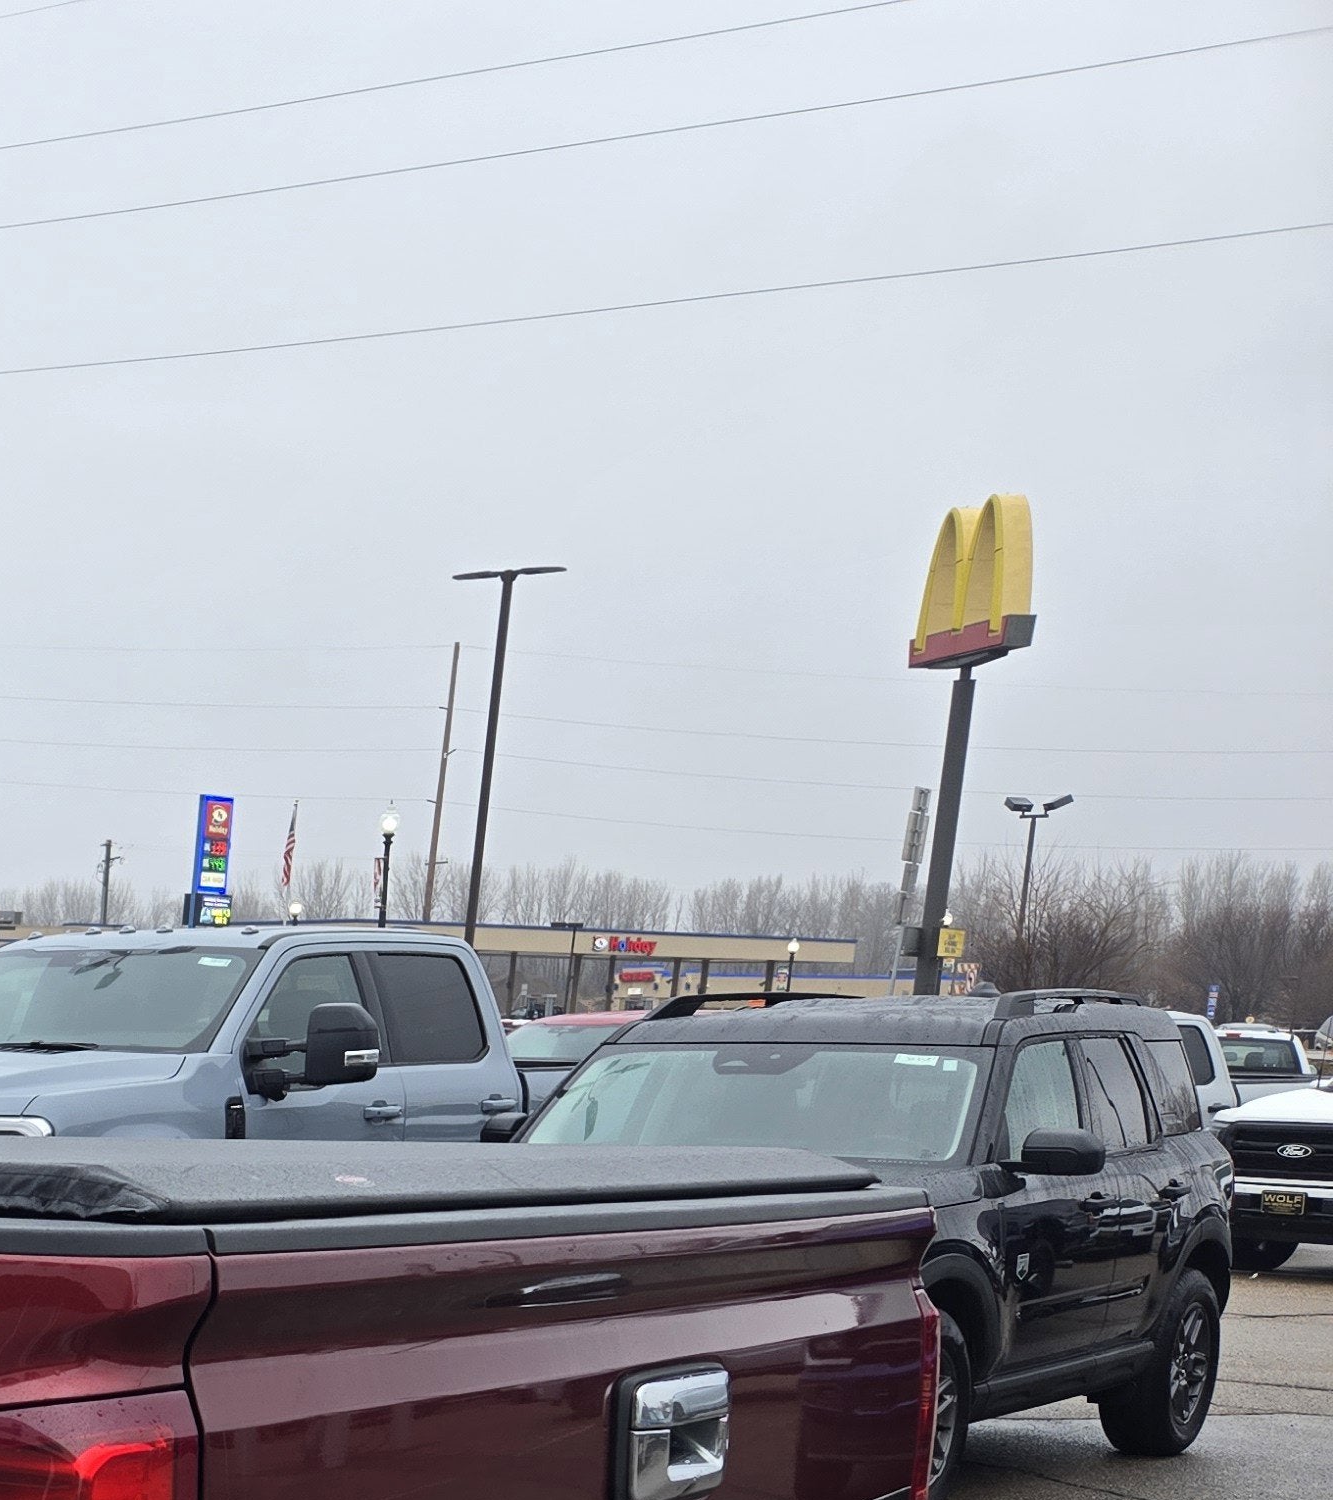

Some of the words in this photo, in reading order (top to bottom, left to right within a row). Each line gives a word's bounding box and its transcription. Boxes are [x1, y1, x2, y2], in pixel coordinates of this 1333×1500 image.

[608, 936, 658, 957] Holiday
[1283, 1145, 1305, 1156] Ford
[1264, 1194, 1303, 1204] WOLF
